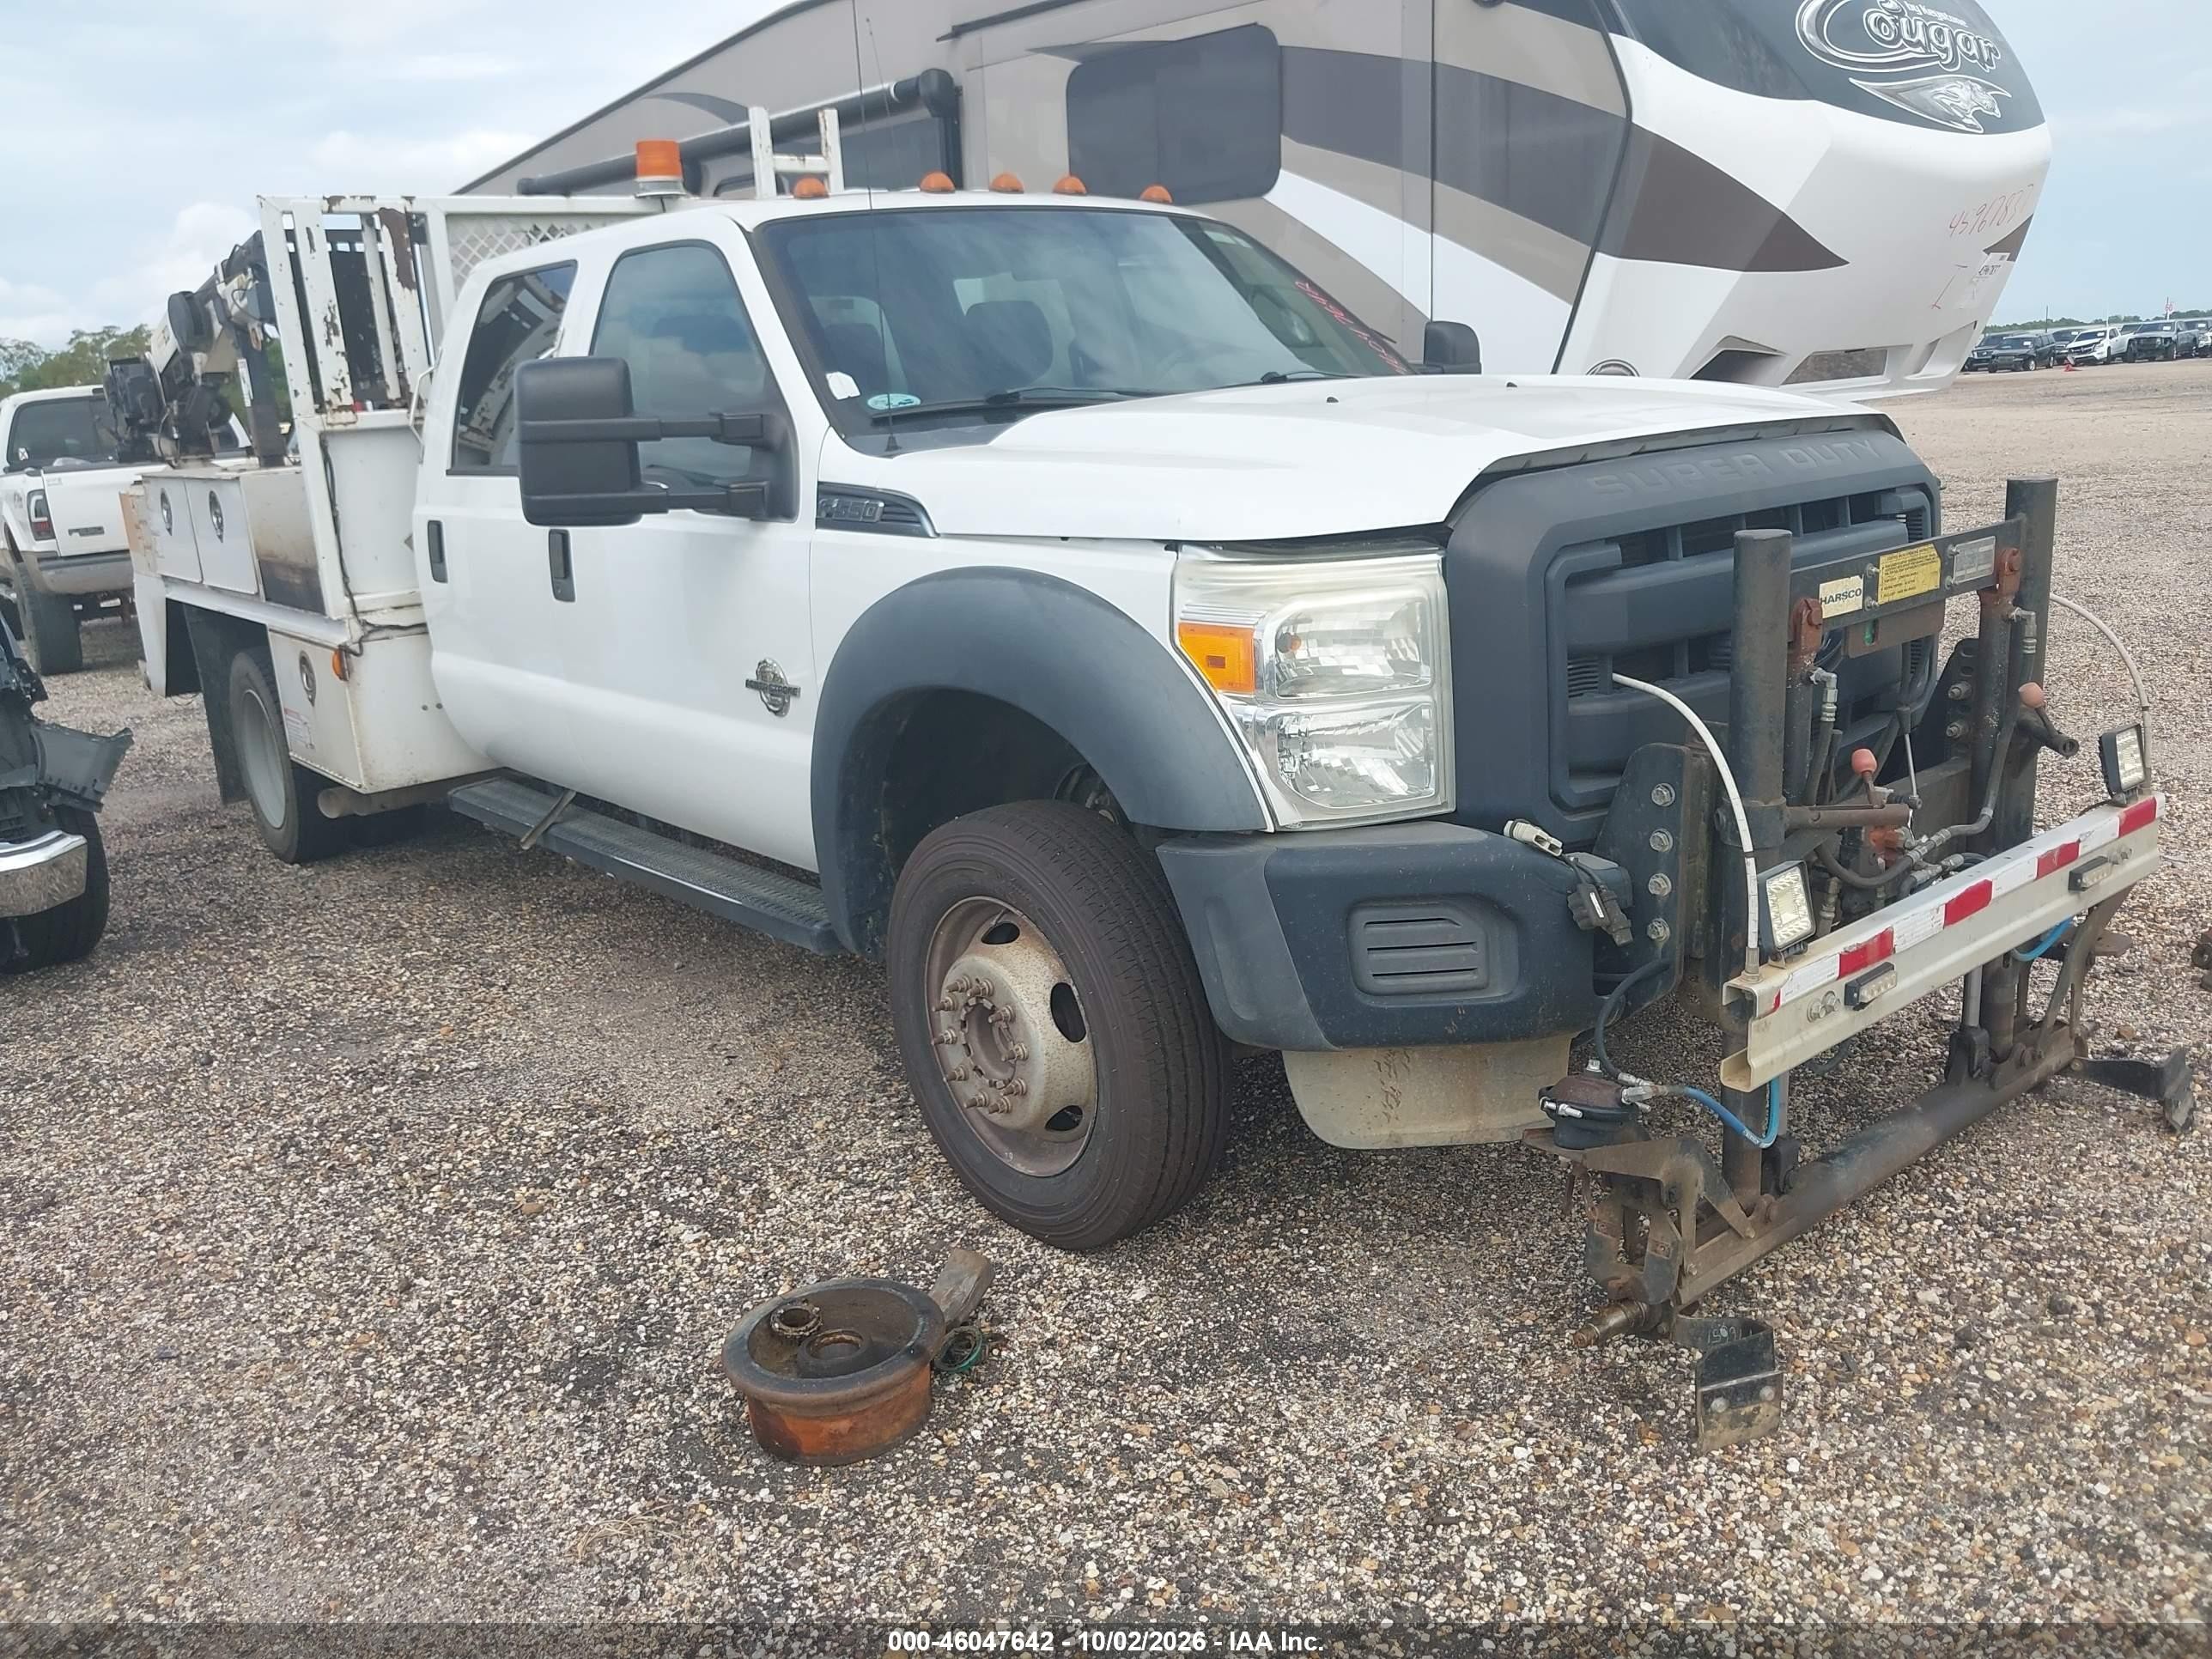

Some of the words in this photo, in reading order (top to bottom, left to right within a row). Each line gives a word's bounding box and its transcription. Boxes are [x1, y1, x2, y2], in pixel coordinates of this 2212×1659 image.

[1795, 0, 2001, 73] Cougar
[1586, 453, 1773, 496] SUPER
[1779, 437, 1884, 470] DUTY
[1820, 587, 1863, 605] HARSCO
